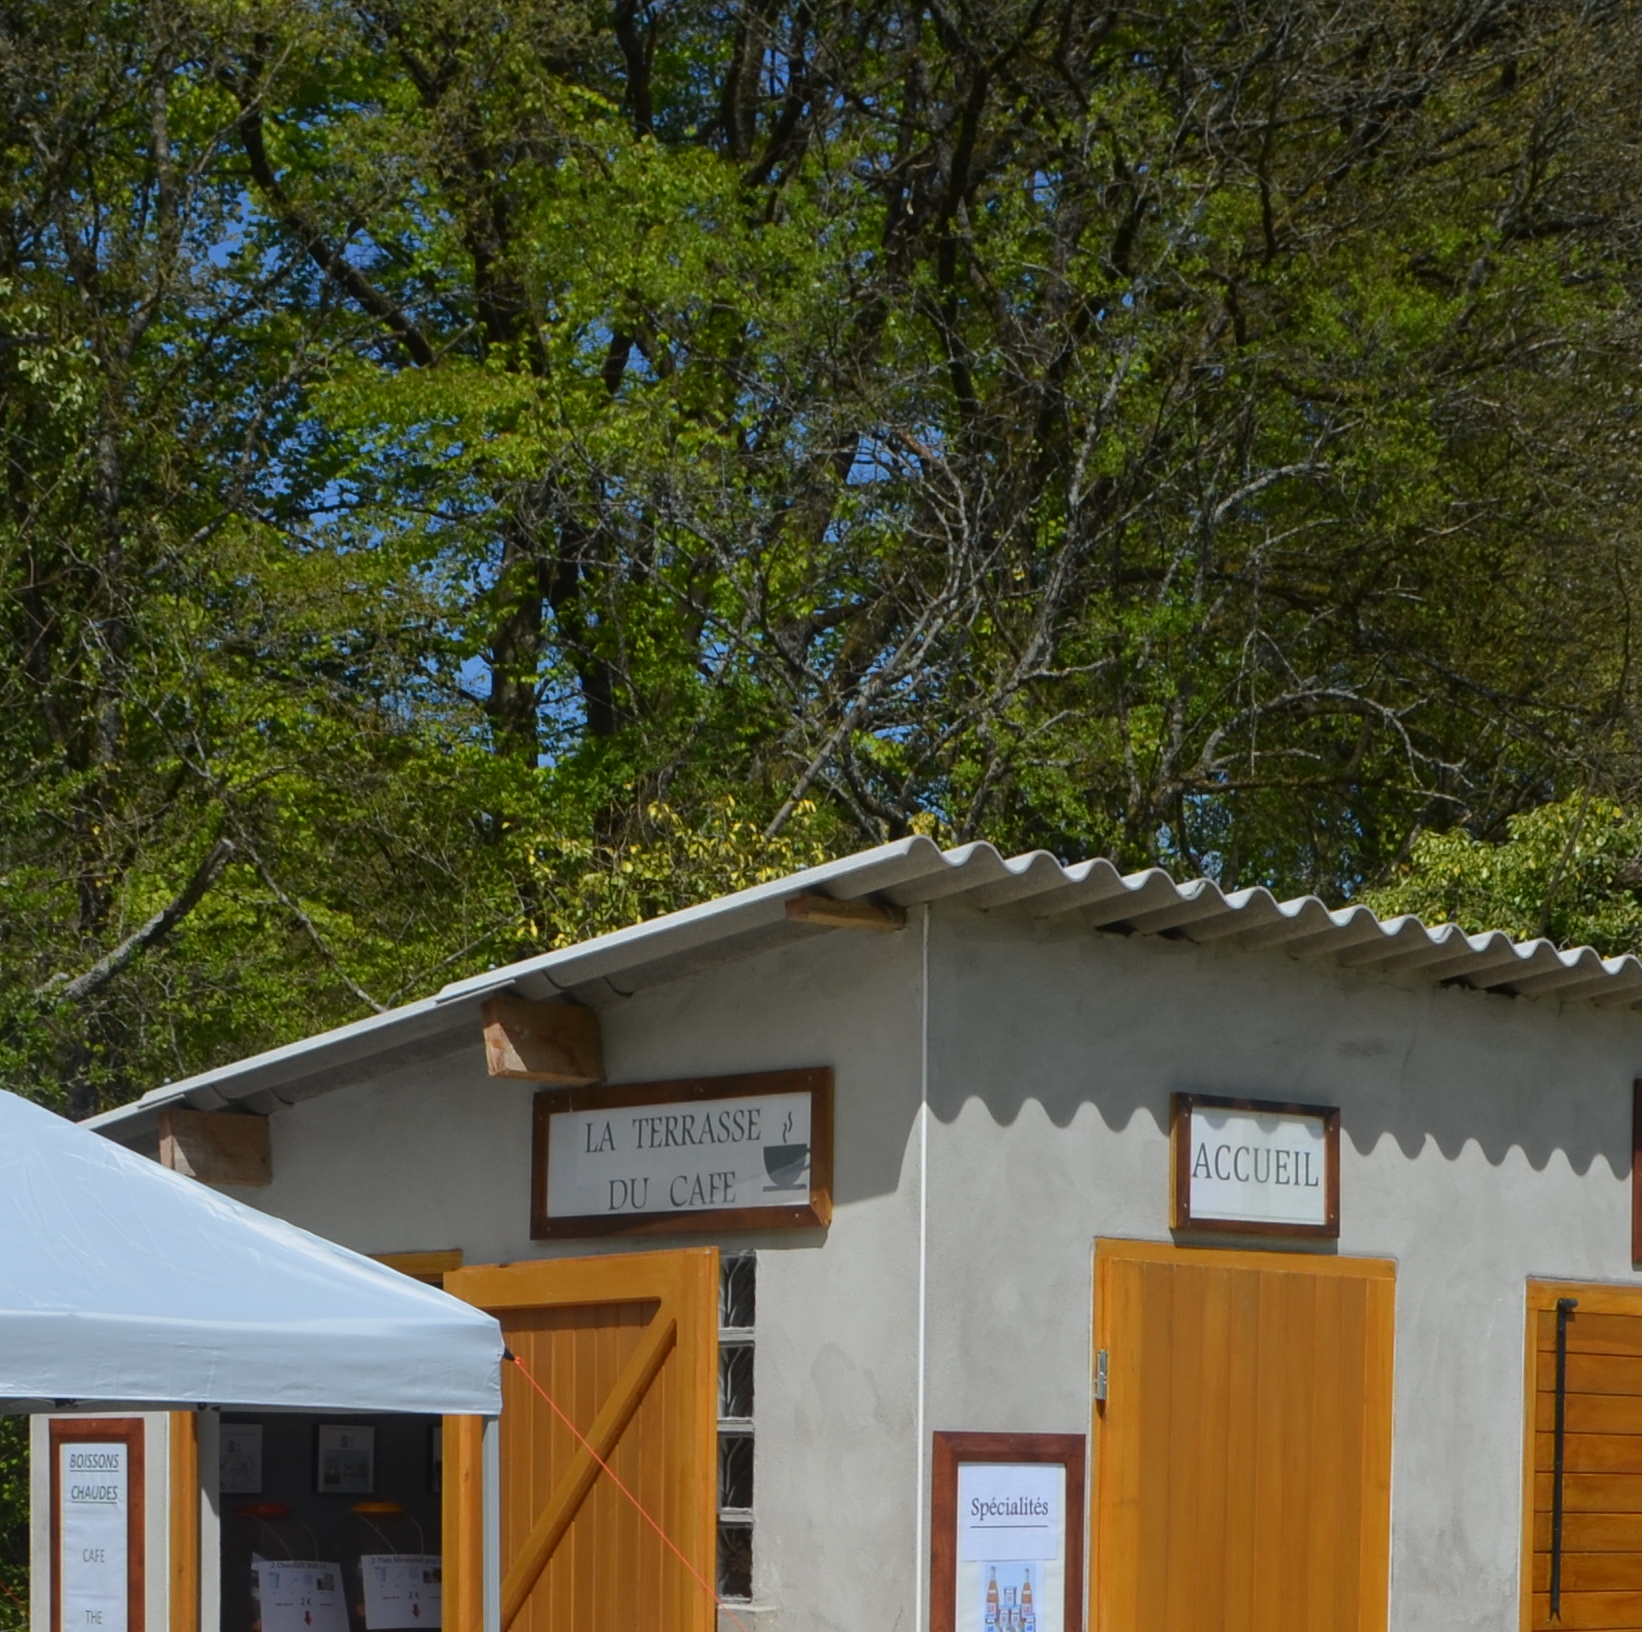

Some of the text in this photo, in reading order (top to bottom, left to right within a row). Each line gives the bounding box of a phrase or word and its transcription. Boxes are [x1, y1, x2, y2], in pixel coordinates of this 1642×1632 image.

[585, 1109, 761, 1153] LA TERRASSE
[1192, 1142, 1319, 1187] ACCUEIL
[608, 1171, 736, 1211] DU CAFE
[69, 1454, 119, 1469] BOISSONS
[71, 1485, 117, 1500] CHAUDES
[971, 1497, 1049, 1521] Spécialités
[83, 1548, 106, 1563] CAFE
[85, 1610, 103, 1625] THE
